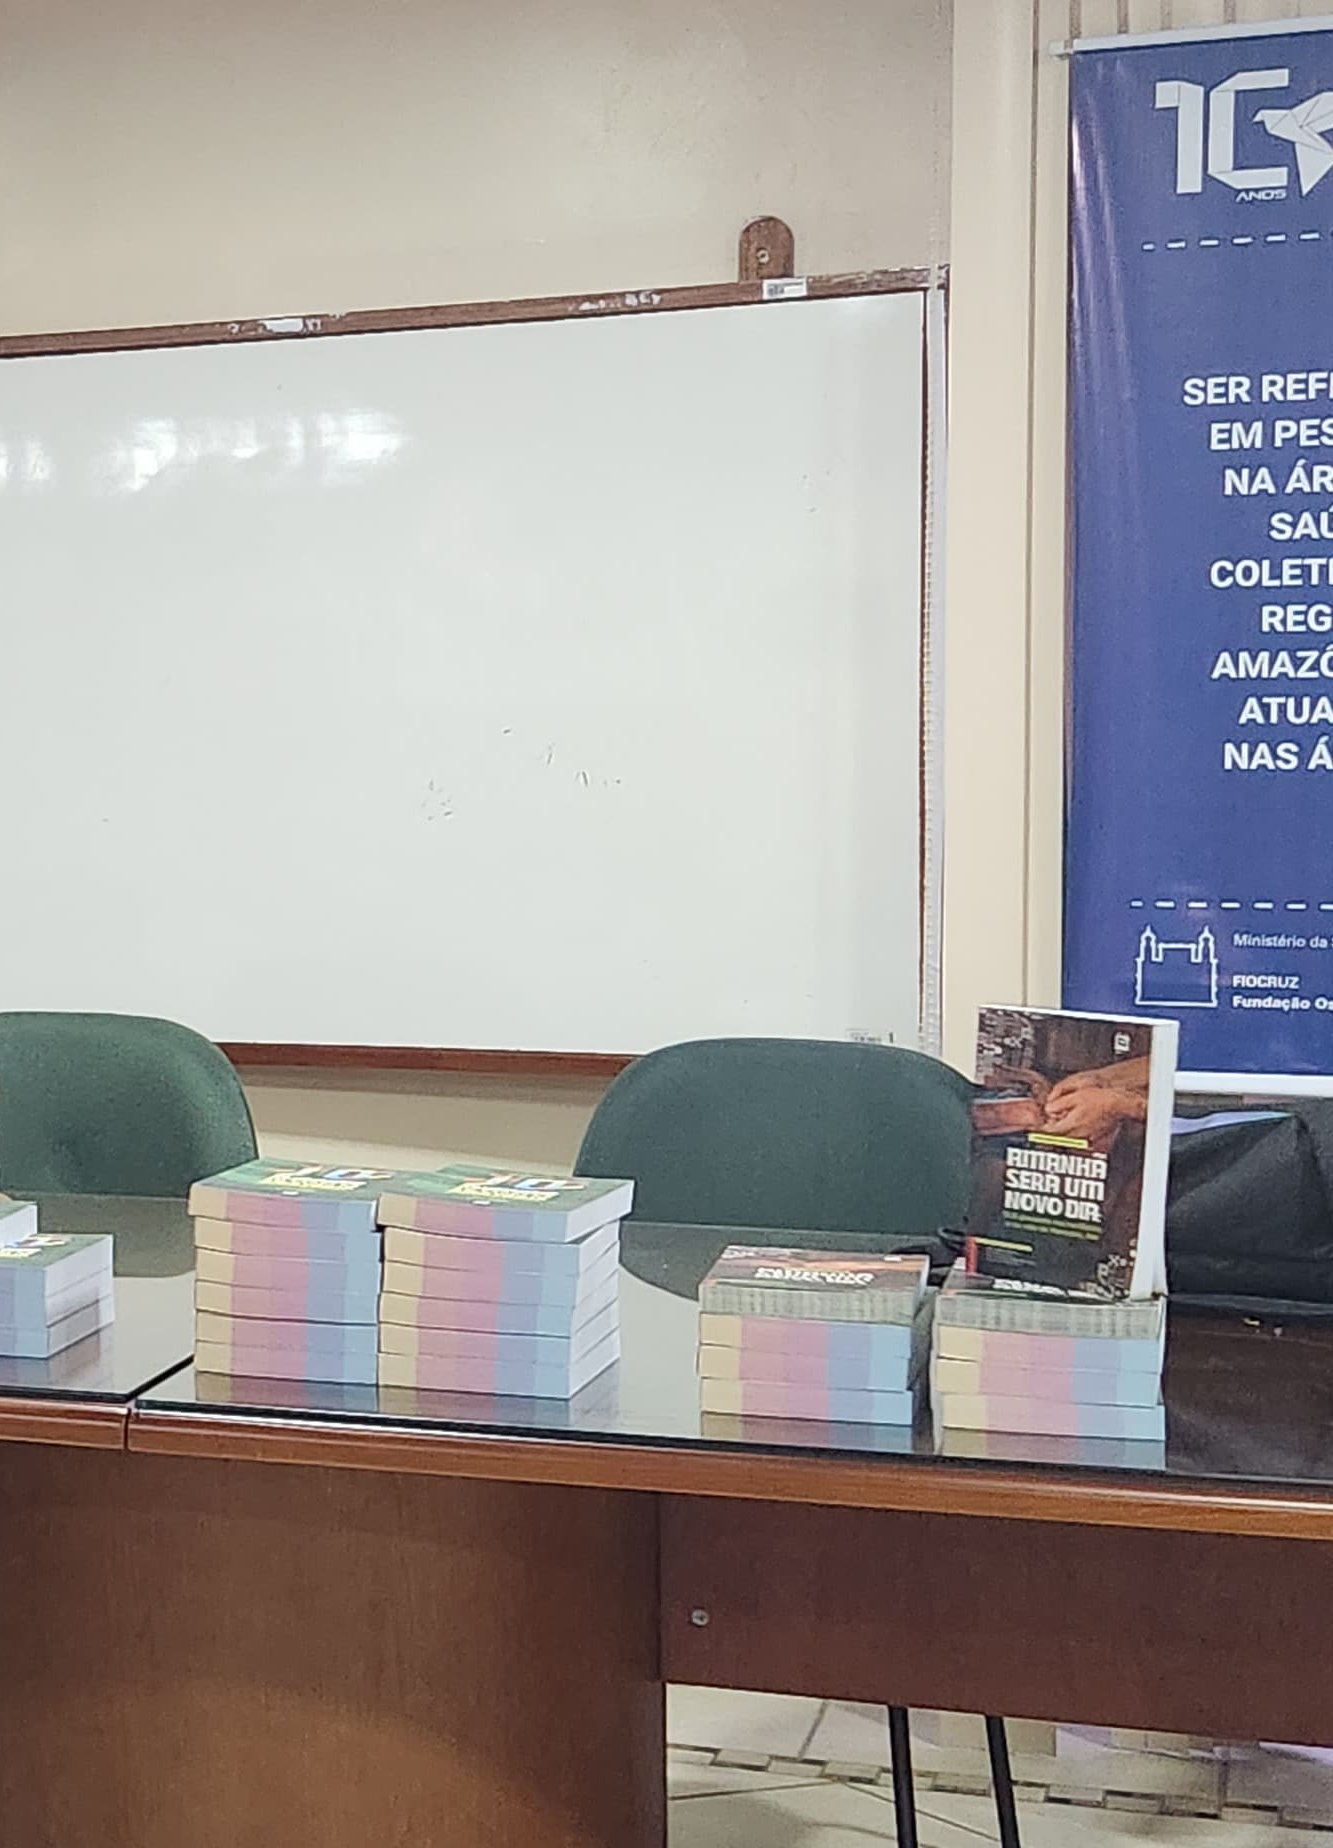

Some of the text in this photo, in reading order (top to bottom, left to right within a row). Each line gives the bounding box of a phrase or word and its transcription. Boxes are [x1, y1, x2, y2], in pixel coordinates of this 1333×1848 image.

[1235, 189, 1286, 202] ANOS
[1183, 375, 1251, 405] SER
[1210, 420, 1263, 451] EM
[1223, 458, 1333, 496] NA ÁR
[1261, 603, 1333, 633] REG
[1223, 742, 1300, 770] NAS
[1233, 932, 1329, 949] Ministério da
[1232, 974, 1300, 990] FIOCRUZ
[1232, 994, 1312, 1013] Fundação
[1006, 1147, 1108, 1180] AMANHÃ
[1064, 1176, 1105, 1202] UM
[1004, 1190, 1064, 1217] NOVO
